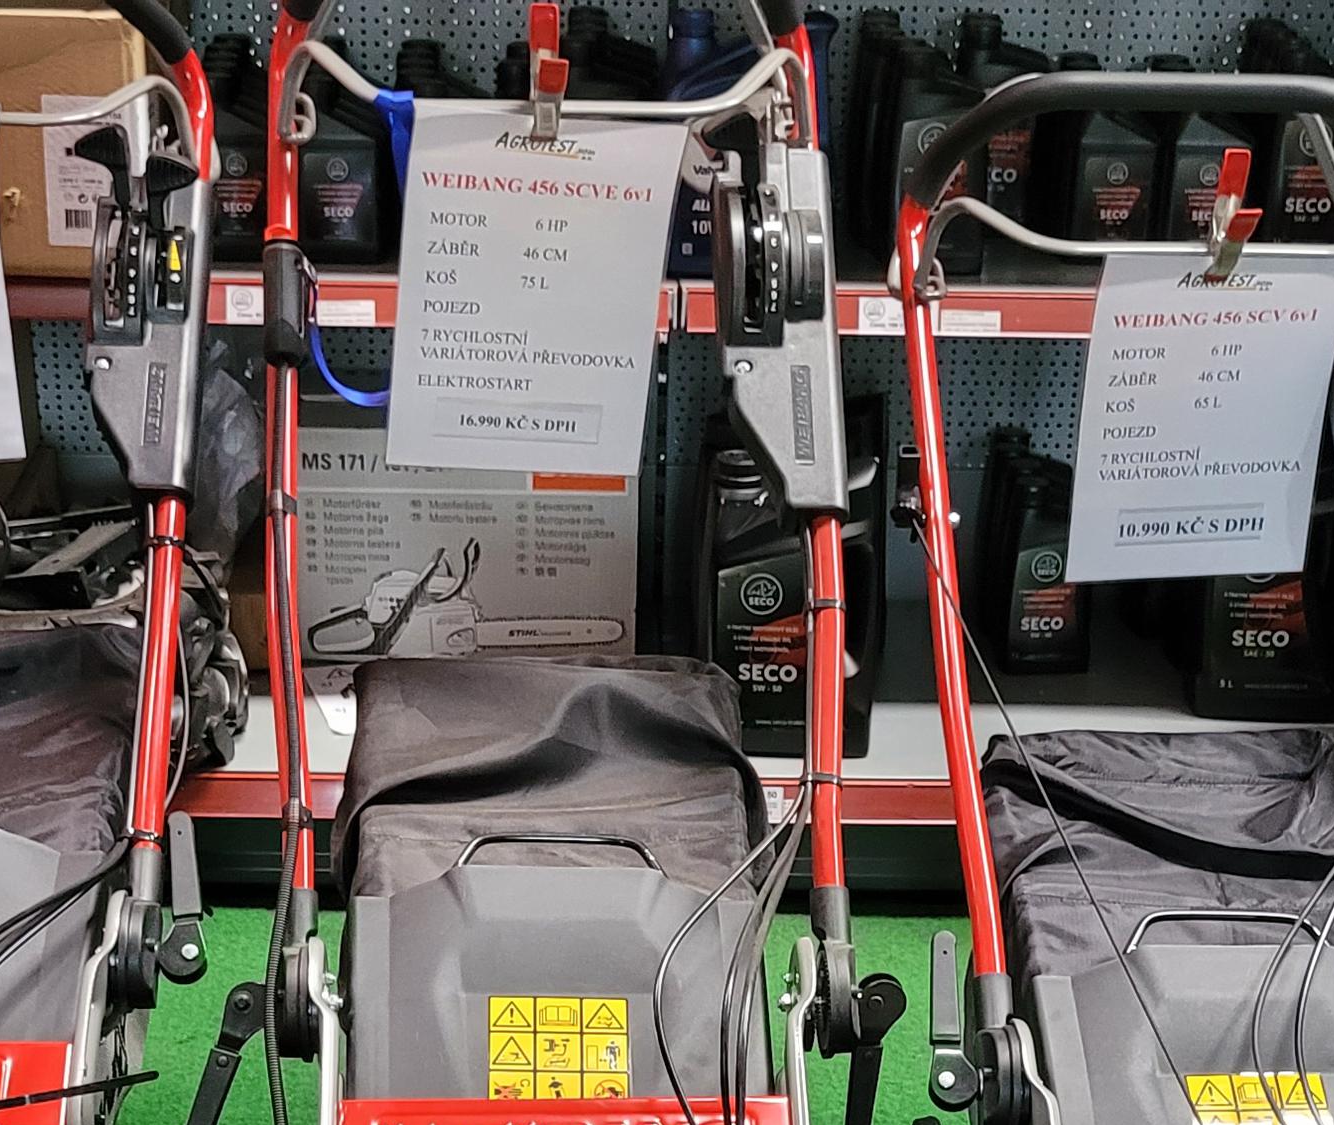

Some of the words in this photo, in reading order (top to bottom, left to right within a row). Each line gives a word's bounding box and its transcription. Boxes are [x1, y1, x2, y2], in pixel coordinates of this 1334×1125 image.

[495, 131, 578, 154] AGROTEST
[422, 171, 522, 194] WEIBANG
[528, 178, 559, 196] 456
[565, 182, 618, 201] SCVE
[222, 202, 253, 213] SECO
[324, 206, 354, 218] SECO
[1100, 209, 1128, 220] SECO
[1285, 198, 1331, 213] SECO
[430, 211, 488, 229] MOTOR
[536, 218, 544, 231] 6
[547, 219, 568, 232] HP
[1192, 210, 1212, 221] SEC
[427, 240, 480, 258] ZÁBĚR
[523, 248, 539, 261] 46
[542, 248, 568, 262] CM
[425, 269, 457, 286] KOŠ
[521, 276, 536, 289] 75
[539, 278, 549, 290] L
[423, 300, 480, 316] POJEZD
[1113, 312, 1208, 329] WEIBANG
[1212, 311, 1242, 325] 456
[1246, 309, 1286, 325] SCV
[421, 329, 429, 342] 7
[432, 327, 528, 346] RYCHLOSTNÍ
[421, 346, 528, 364] VARIÁTOROVÁ
[532, 351, 635, 369] PŘEVODOVKA
[1112, 347, 1167, 361] MOTOR
[1211, 345, 1219, 357] 6
[1220, 344, 1242, 357] HP
[418, 374, 533, 391] ELEKTROSTART
[1107, 372, 1157, 387] ZÁBĚR
[1197, 371, 1214, 383] 46
[1217, 370, 1241, 382] CM
[1105, 397, 1135, 413] KOŠ
[1194, 397, 1209, 409] 65
[1212, 397, 1222, 409] L
[459, 414, 501, 430] 16.990
[505, 414, 528, 431] KČ
[531, 419, 541, 431] S
[544, 419, 576, 433] DPH
[1103, 426, 1156, 440] POJEZD
[302, 452, 332, 471] MS
[339, 454, 364, 471] 171
[1101, 453, 1108, 465] 7
[1110, 447, 1201, 464] RYCHLOSTNÍ
[1098, 463, 1199, 482] VARIÁTOROVÁ
[1204, 460, 1301, 476] PŘEVODOVKA
[1118, 522, 1170, 538] 10.990
[1176, 517, 1204, 535] KČ
[1208, 519, 1218, 533] S
[1225, 517, 1264, 533] DPH
[748, 597, 775, 606] SECO
[1021, 616, 1064, 631] SECO
[1231, 630, 1290, 648] SECO
[738, 663, 798, 682] SECO
